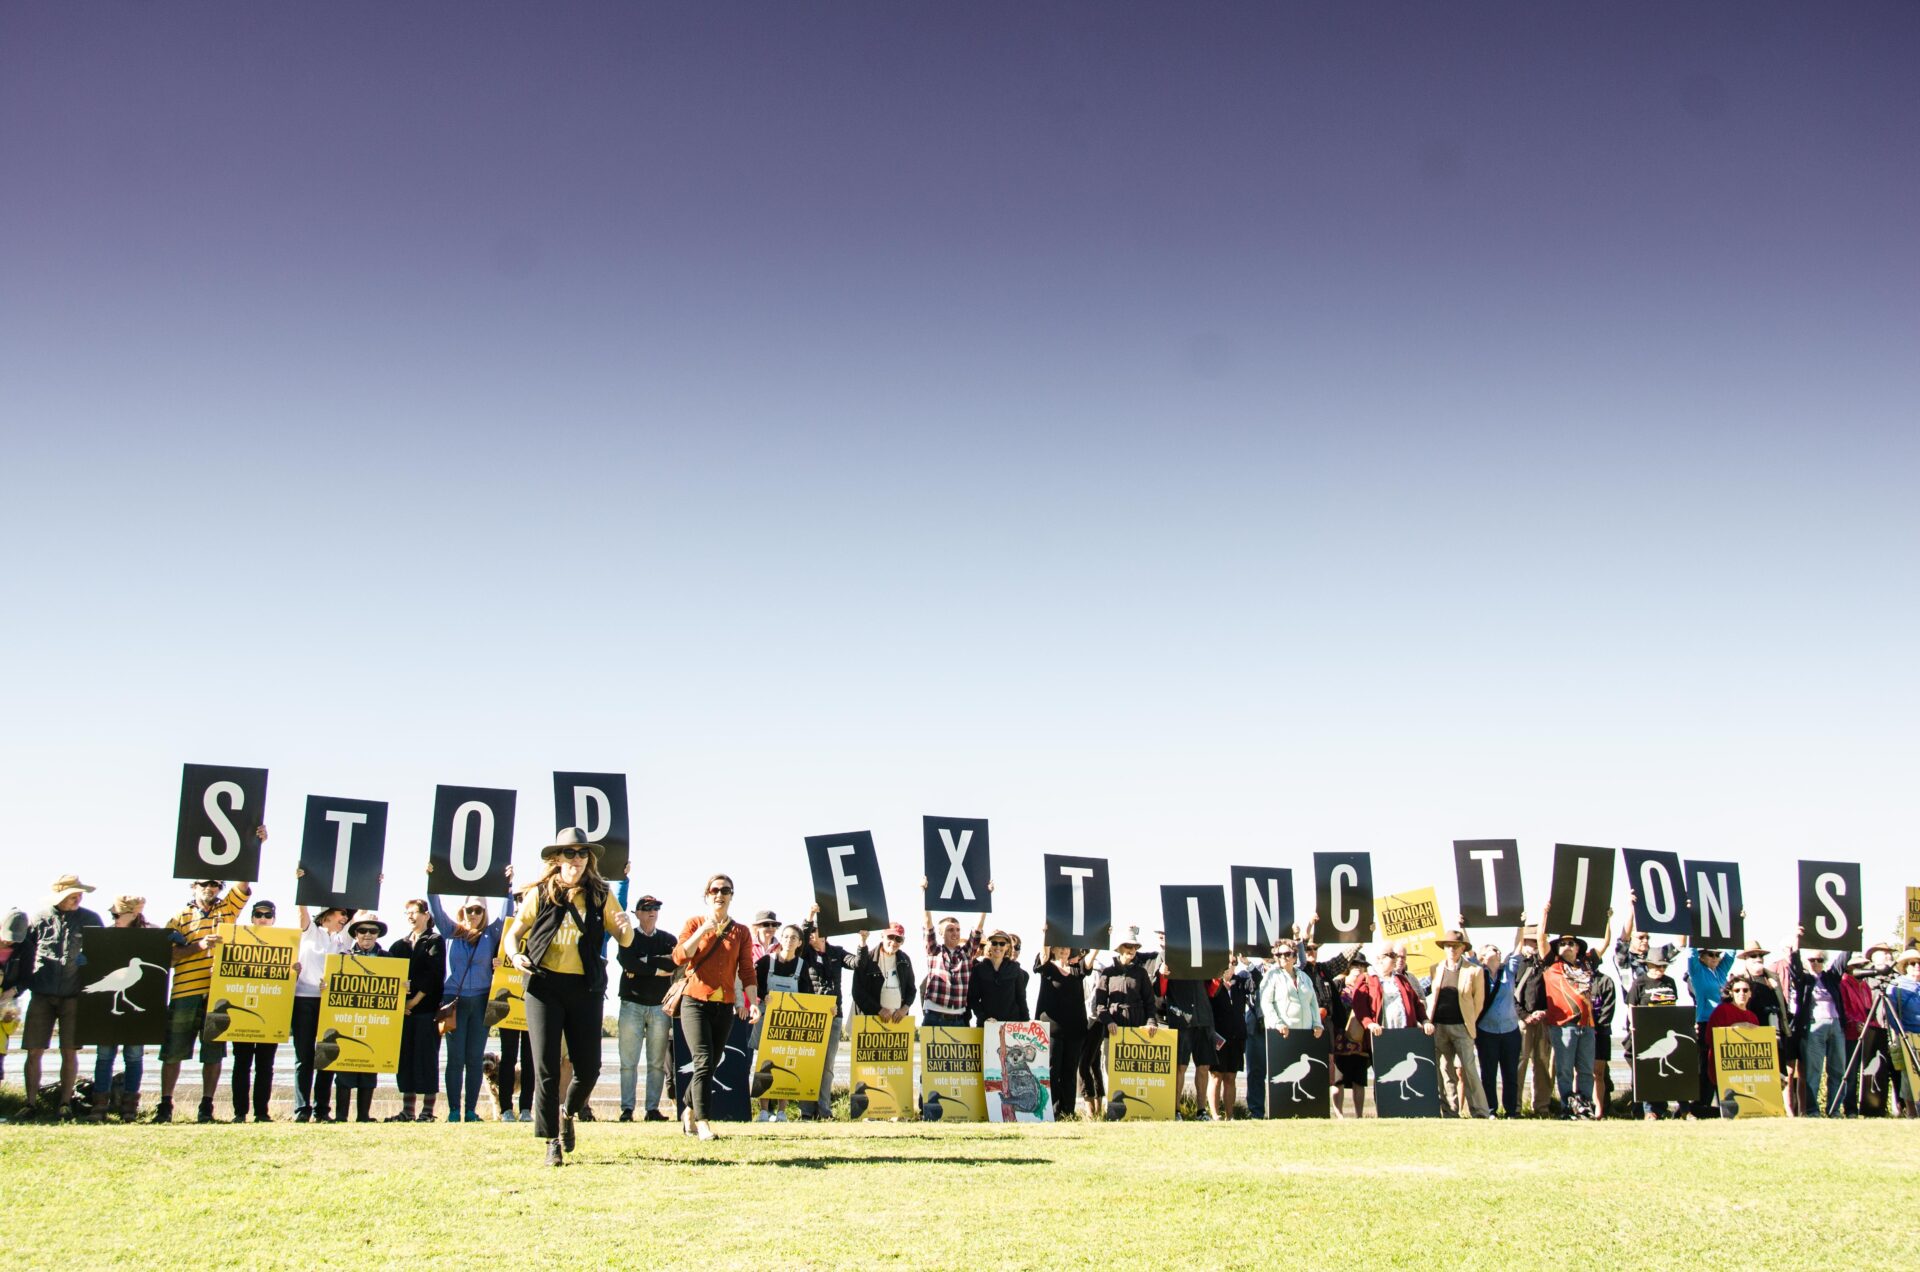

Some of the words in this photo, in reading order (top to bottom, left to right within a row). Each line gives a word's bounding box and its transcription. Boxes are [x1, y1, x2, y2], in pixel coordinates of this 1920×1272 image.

[199, 781, 245, 866] S
[450, 800, 495, 882] O
[325, 810, 367, 894] T
[938, 829, 977, 901] X
[827, 845, 868, 923] E
[1469, 850, 1504, 917] T
[1570, 857, 1590, 926] I
[1639, 859, 1676, 923] O
[1060, 866, 1094, 937] T
[1330, 861, 1360, 933] C
[1696, 871, 1731, 939] N
[1814, 872, 1848, 940] S
[1245, 877, 1280, 953] N
[1383, 902, 1434, 924] TOONDAH
[1186, 896, 1203, 968] I
[1386, 923, 1405, 935] SAVE
[1405, 920, 1421, 931] THE
[1421, 916, 1437, 927] BAY
[225, 945, 291, 964] TOONDAH
[221, 963, 246, 977] SAVE
[249, 965, 267, 978] THE
[270, 966, 289, 979] BAY
[226, 984, 244, 993] vote
[246, 983, 258, 993] for
[261, 984, 282, 995] birds
[333, 975, 399, 995] TOONDAH
[330, 994, 354, 1007] SAVE
[357, 995, 374, 1008] THE
[378, 997, 398, 1009] BAY
[334, 1014, 352, 1023] vote
[354, 1013, 367, 1024] for
[368, 1014, 390, 1025] birds
[773, 1011, 826, 1029] TOONDAH
[768, 1028, 789, 1040] SAVE
[790, 1029, 805, 1040] THE
[807, 1031, 824, 1042] BAY
[859, 1033, 908, 1048] TOONDAH
[771, 1046, 785, 1054] vote
[787, 1046, 797, 1055] for
[798, 1047, 816, 1056] birds
[857, 1050, 876, 1061] SAVE
[878, 1050, 892, 1061] THE
[893, 1050, 908, 1061] BAY
[928, 1044, 980, 1059] TOONDAH
[1117, 1045, 1170, 1060] TOONDAH
[1722, 1043, 1772, 1057] TOONDAH
[928, 1060, 947, 1072] SAVE
[949, 1060, 963, 1072] THE
[965, 1060, 981, 1072] BAY
[1115, 1060, 1135, 1071] SAVE
[1137, 1061, 1152, 1072] THE
[1154, 1062, 1170, 1073] BAY
[1721, 1059, 1741, 1070] SAVE
[1742, 1059, 1756, 1069] THE
[1758, 1059, 1773, 1069] BAY
